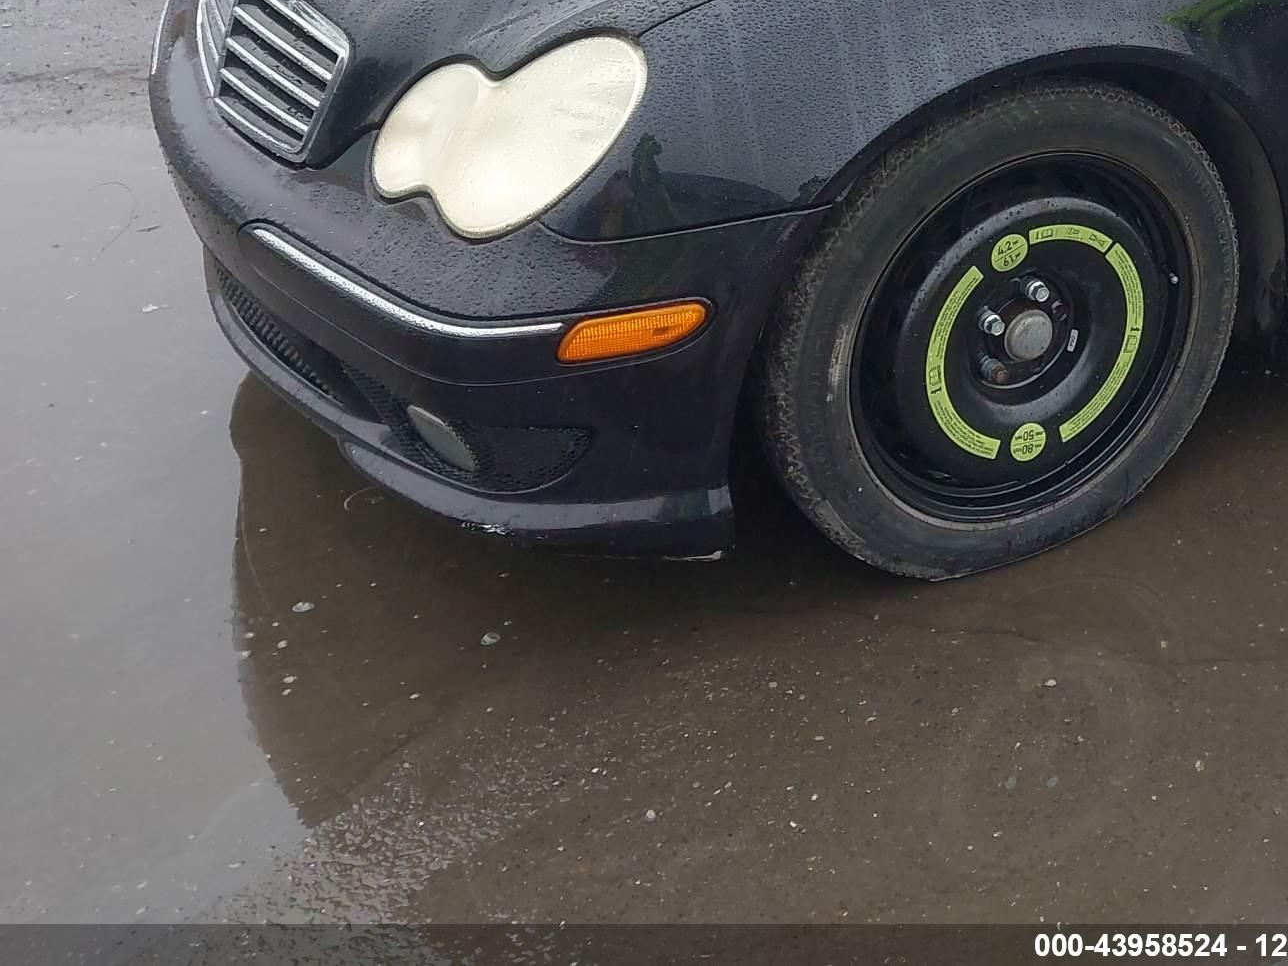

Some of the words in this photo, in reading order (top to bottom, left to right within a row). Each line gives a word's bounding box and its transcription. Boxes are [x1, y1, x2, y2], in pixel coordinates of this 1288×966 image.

[997, 240, 1013, 256] 4.2
[1023, 430, 1034, 441] 50
[1022, 444, 1034, 455] 80
